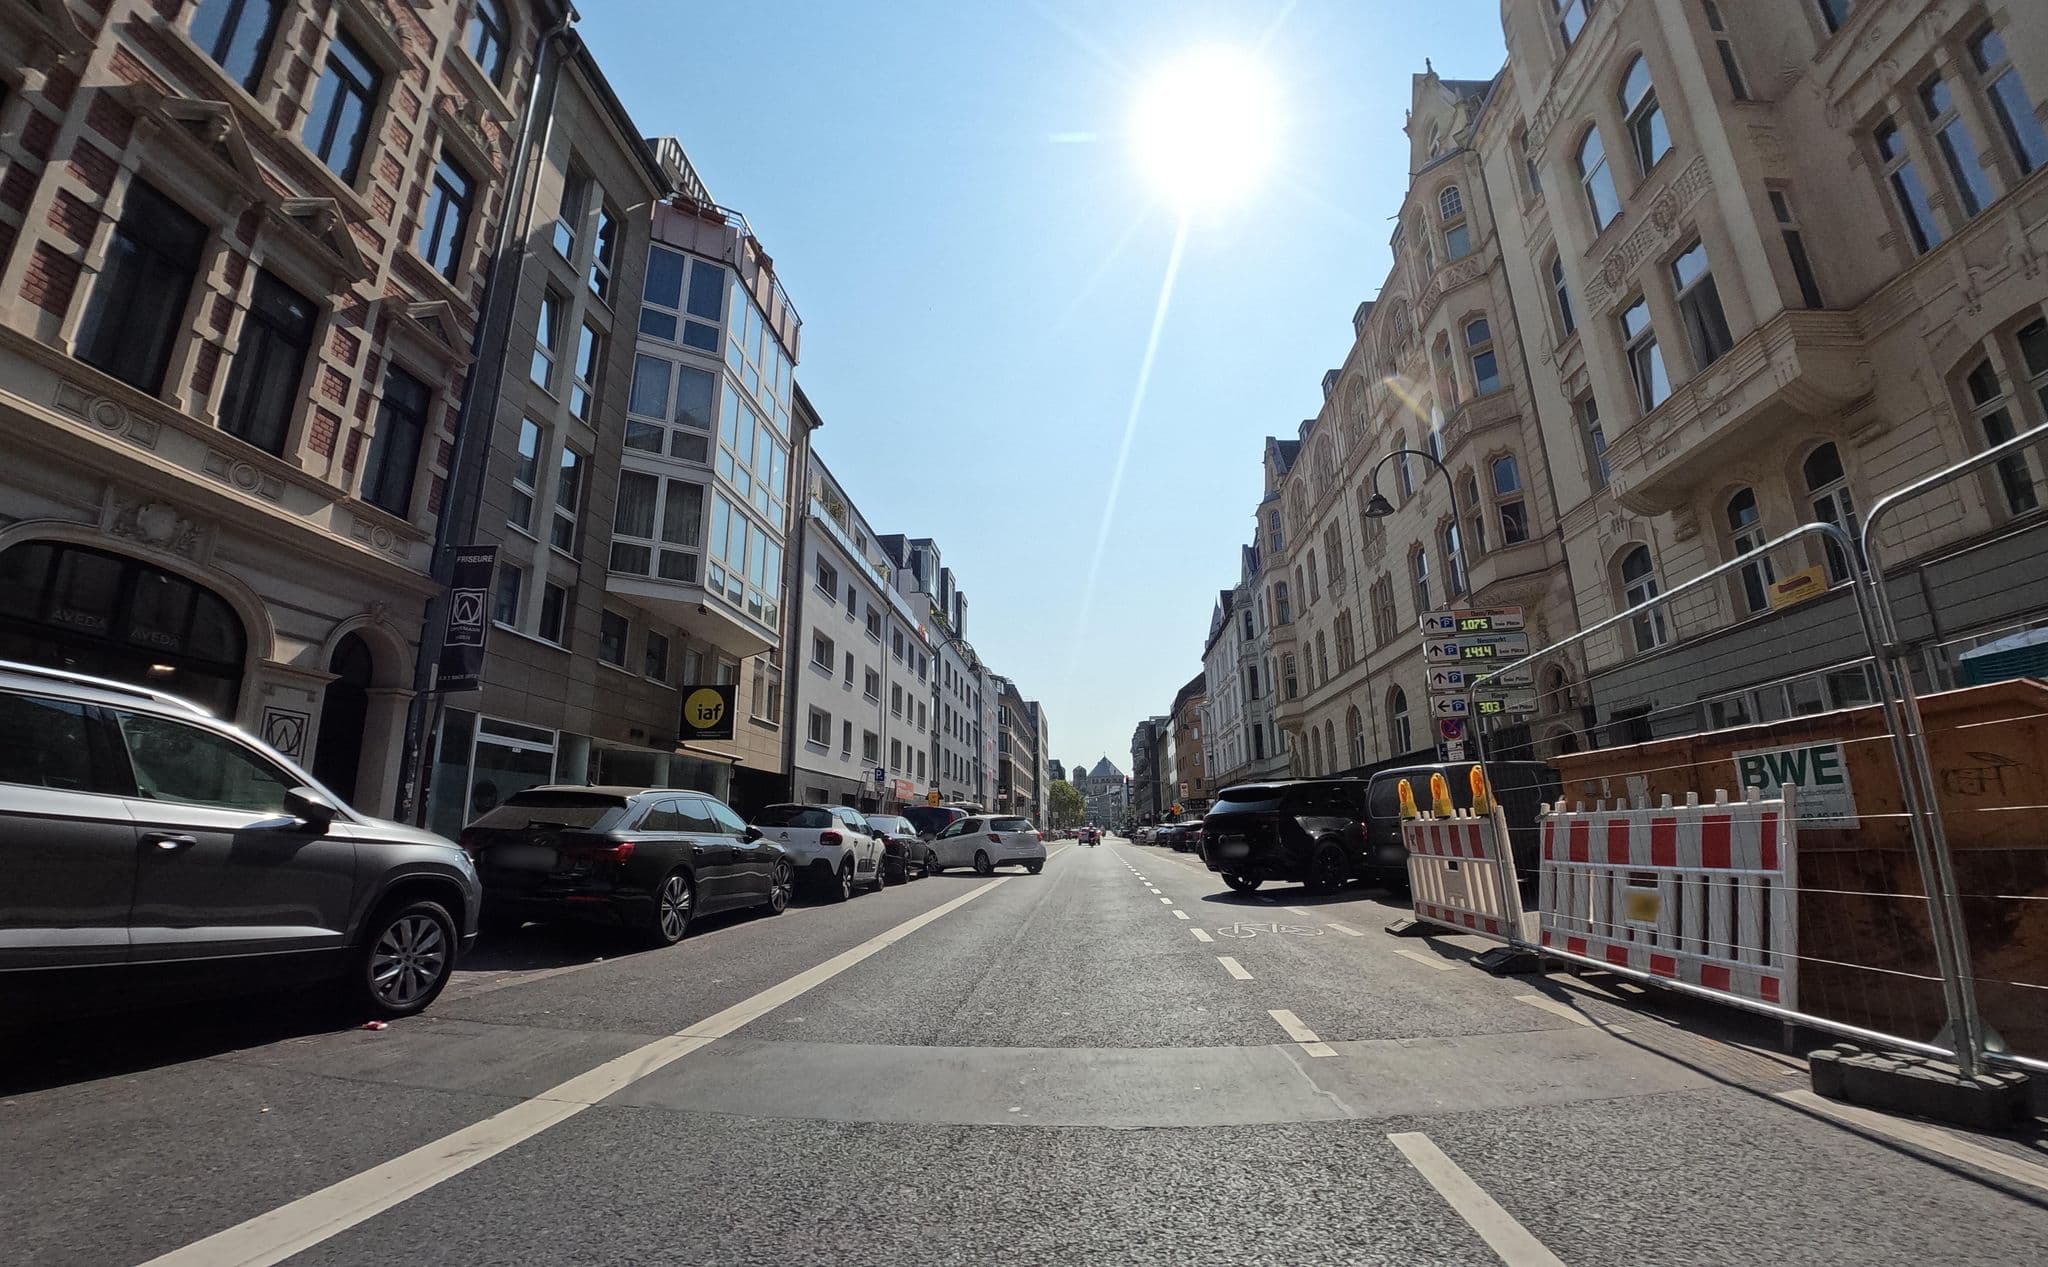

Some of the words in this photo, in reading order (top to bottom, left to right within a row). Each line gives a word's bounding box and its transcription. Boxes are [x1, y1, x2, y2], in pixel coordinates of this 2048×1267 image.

[1461, 619, 1487, 630] 1075
[1464, 646, 1492, 657] 1414
[697, 703, 722, 720] iaf
[1479, 702, 1500, 713] 303
[1739, 745, 1844, 790] BWE
